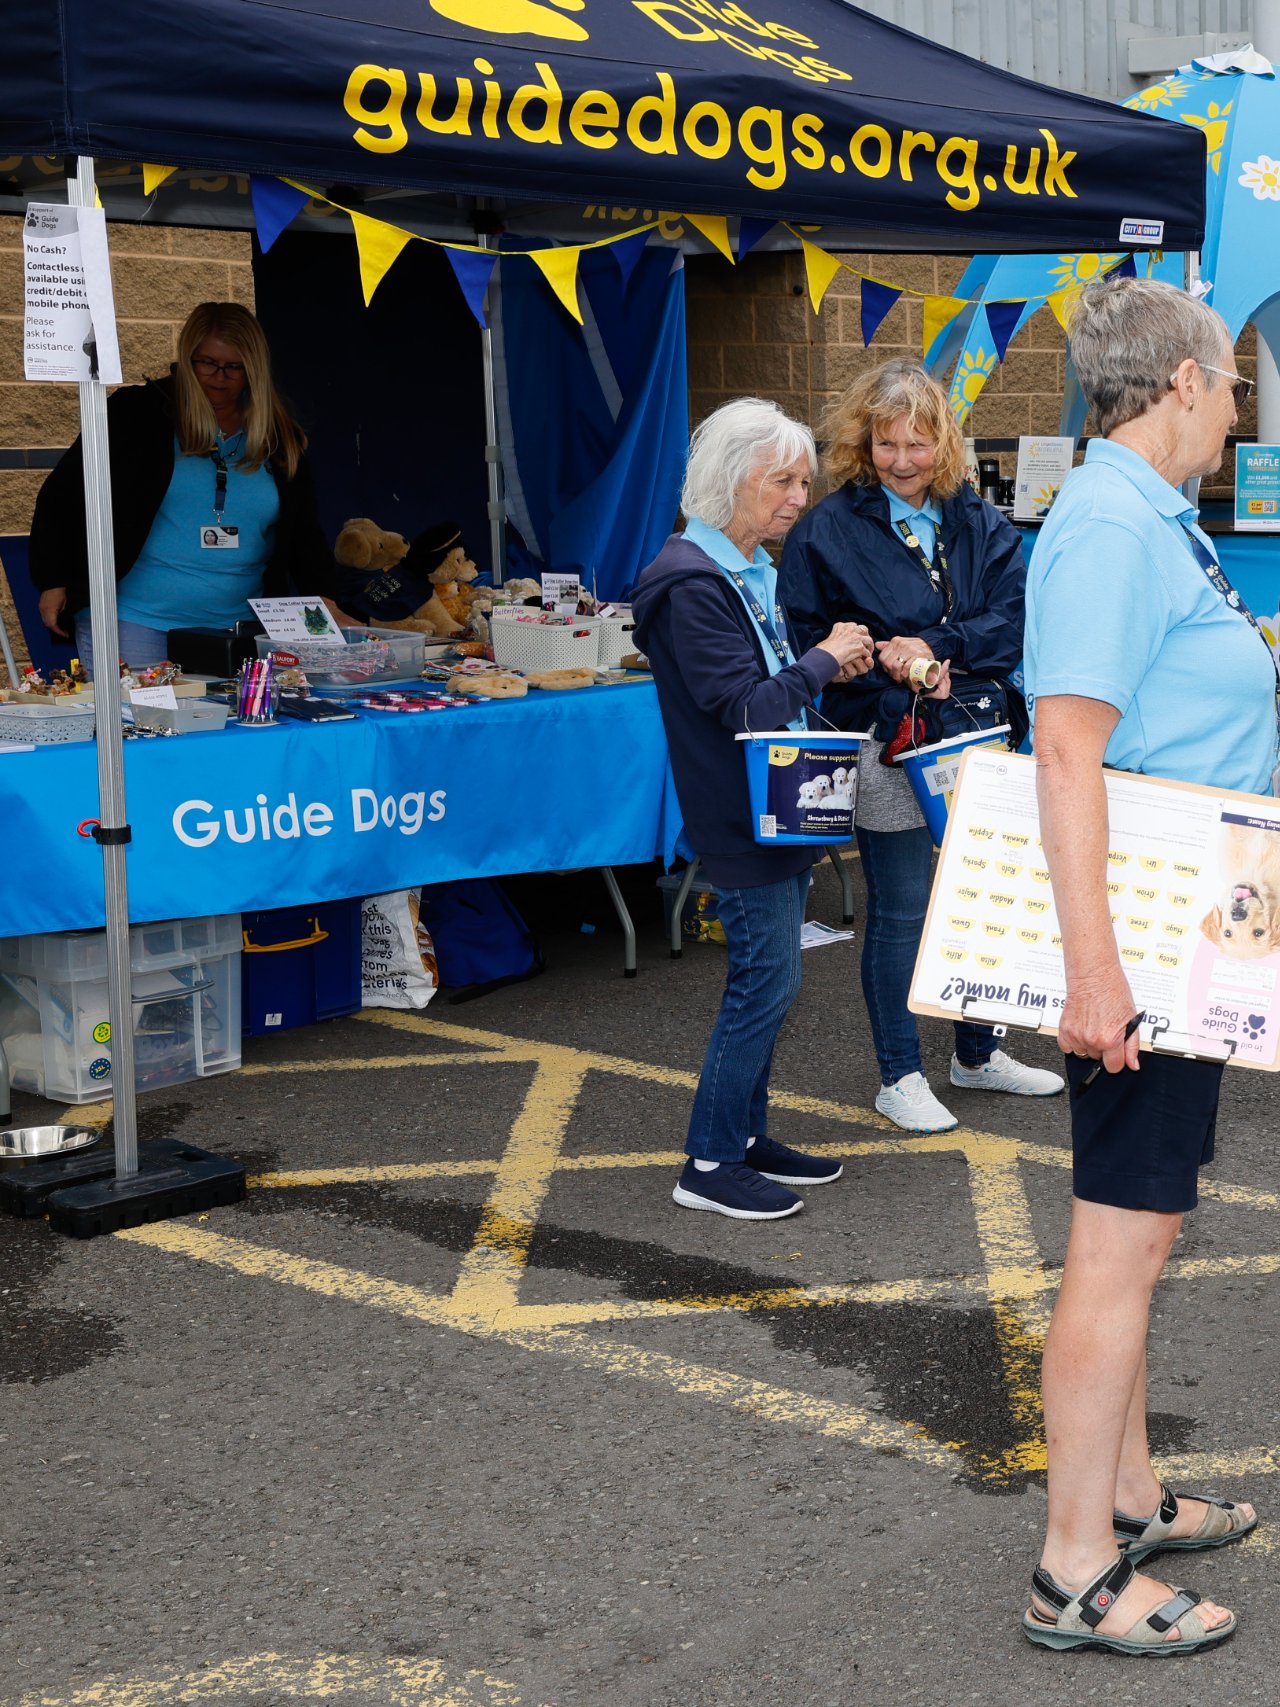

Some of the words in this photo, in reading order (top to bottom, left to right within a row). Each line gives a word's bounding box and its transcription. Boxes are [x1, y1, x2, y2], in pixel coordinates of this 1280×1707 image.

[631, 1, 853, 83] Dogs
[343, 57, 1079, 211] guidedogs.org.uk
[41, 215, 59, 223] Guide
[41, 222, 57, 230] Dogs
[27, 244, 39, 253] No
[40, 245, 67, 255] Cash?
[27, 262, 80, 273] Contactless
[27, 275, 69, 284] available
[27, 287, 83, 298] credit/debit
[27, 299, 60, 309] mobile
[26, 316, 55, 326] Please
[26, 329, 40, 338] ask
[42, 329, 56, 338] for
[26, 342, 76, 352] assistance.
[1247, 458, 1280, 466] RAFFLE
[1213, 578, 1224, 592] Dogs
[1218, 574, 1229, 590] Guide
[804, 752, 828, 761] Please
[829, 755, 851, 763] support
[172, 793, 335, 848] Guide
[351, 788, 447, 836] Dogs
[1002, 834, 1030, 845] Yannika
[962, 855, 987, 869] Sparky
[1108, 852, 1127, 864] Vespa
[1146, 859, 1157, 868] Uri
[1001, 865, 1016, 875] Rolo
[1173, 864, 1199, 876] Thomas
[958, 888, 978, 899] Major
[1106, 884, 1119, 893] Orl
[1136, 888, 1155, 899] Orion
[989, 894, 1015, 905] Maddie
[1027, 900, 1045, 911] Lewis
[952, 919, 971, 929] Gwen
[1130, 918, 1148, 929] Irene
[368, 924, 392, 936] this
[986, 924, 1005, 935] Frank
[1166, 925, 1184, 935] Hugo
[1021, 931, 1038, 940] Erica
[946, 950, 963, 960] Alfie
[1121, 948, 1145, 960] Breeze
[1158, 953, 1178, 966] Beccy
[980, 956, 997, 966] Ailsa
[940, 977, 1011, 1002] name?
[1017, 983, 1048, 1009] my
[1208, 1006, 1239, 1022] Dogs
[1202, 1018, 1237, 1033] Guide
[1240, 1042, 1253, 1050] aid
[1254, 1044, 1263, 1052] In
